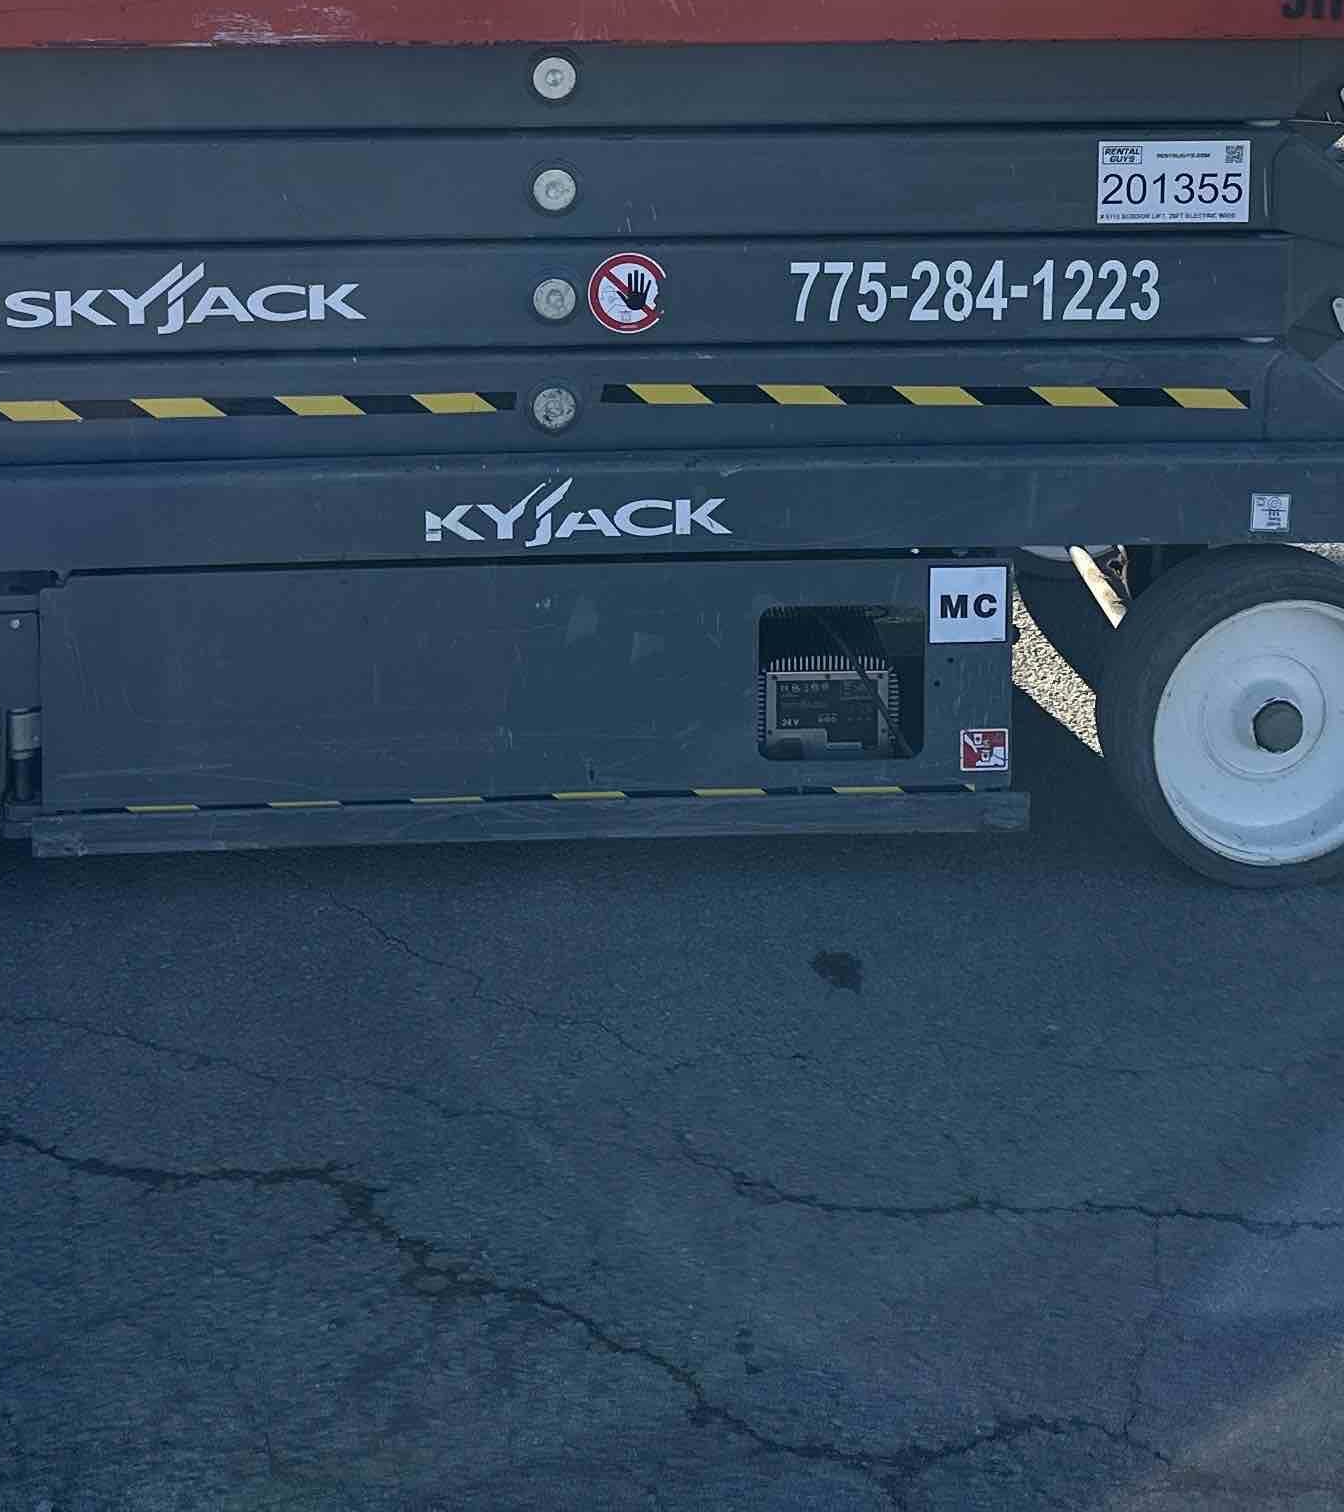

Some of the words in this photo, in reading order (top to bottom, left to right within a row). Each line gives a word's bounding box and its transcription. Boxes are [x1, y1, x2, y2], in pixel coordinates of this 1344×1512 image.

[1101, 172, 1243, 205] 201355
[3, 262, 368, 336] SKYJACK
[789, 260, 1161, 323] 775-284-1223
[425, 477, 733, 548] KYJACK
[939, 593, 998, 619] MC
